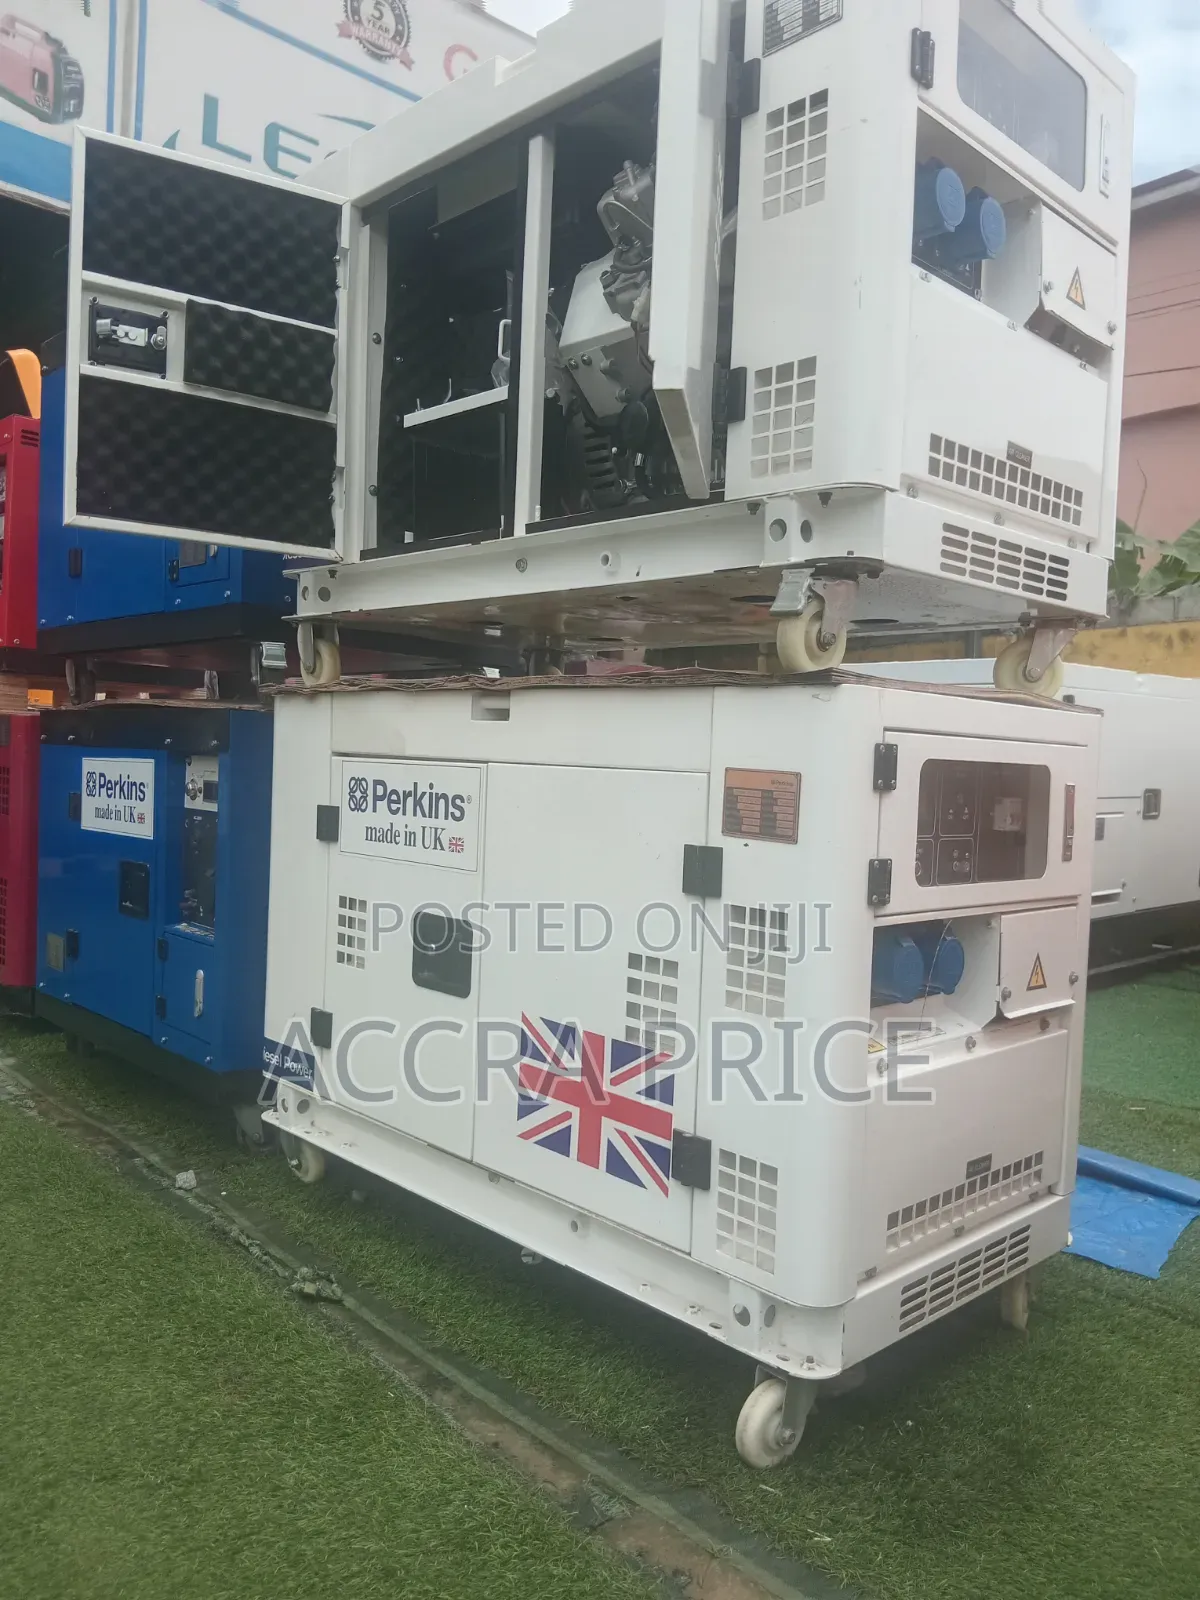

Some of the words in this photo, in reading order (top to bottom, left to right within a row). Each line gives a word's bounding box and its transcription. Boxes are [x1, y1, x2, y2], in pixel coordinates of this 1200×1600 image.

[369, 1, 386, 21] 5
[367, 18, 390, 35] YEAR
[94, 804, 114, 821] made
[114, 805, 122, 822] in
[123, 805, 137, 824] UK
[365, 822, 401, 846] made
[403, 823, 417, 848] in
[420, 825, 447, 852] UK
[262, 1045, 283, 1068] iesel
[283, 1055, 313, 1080] Power
